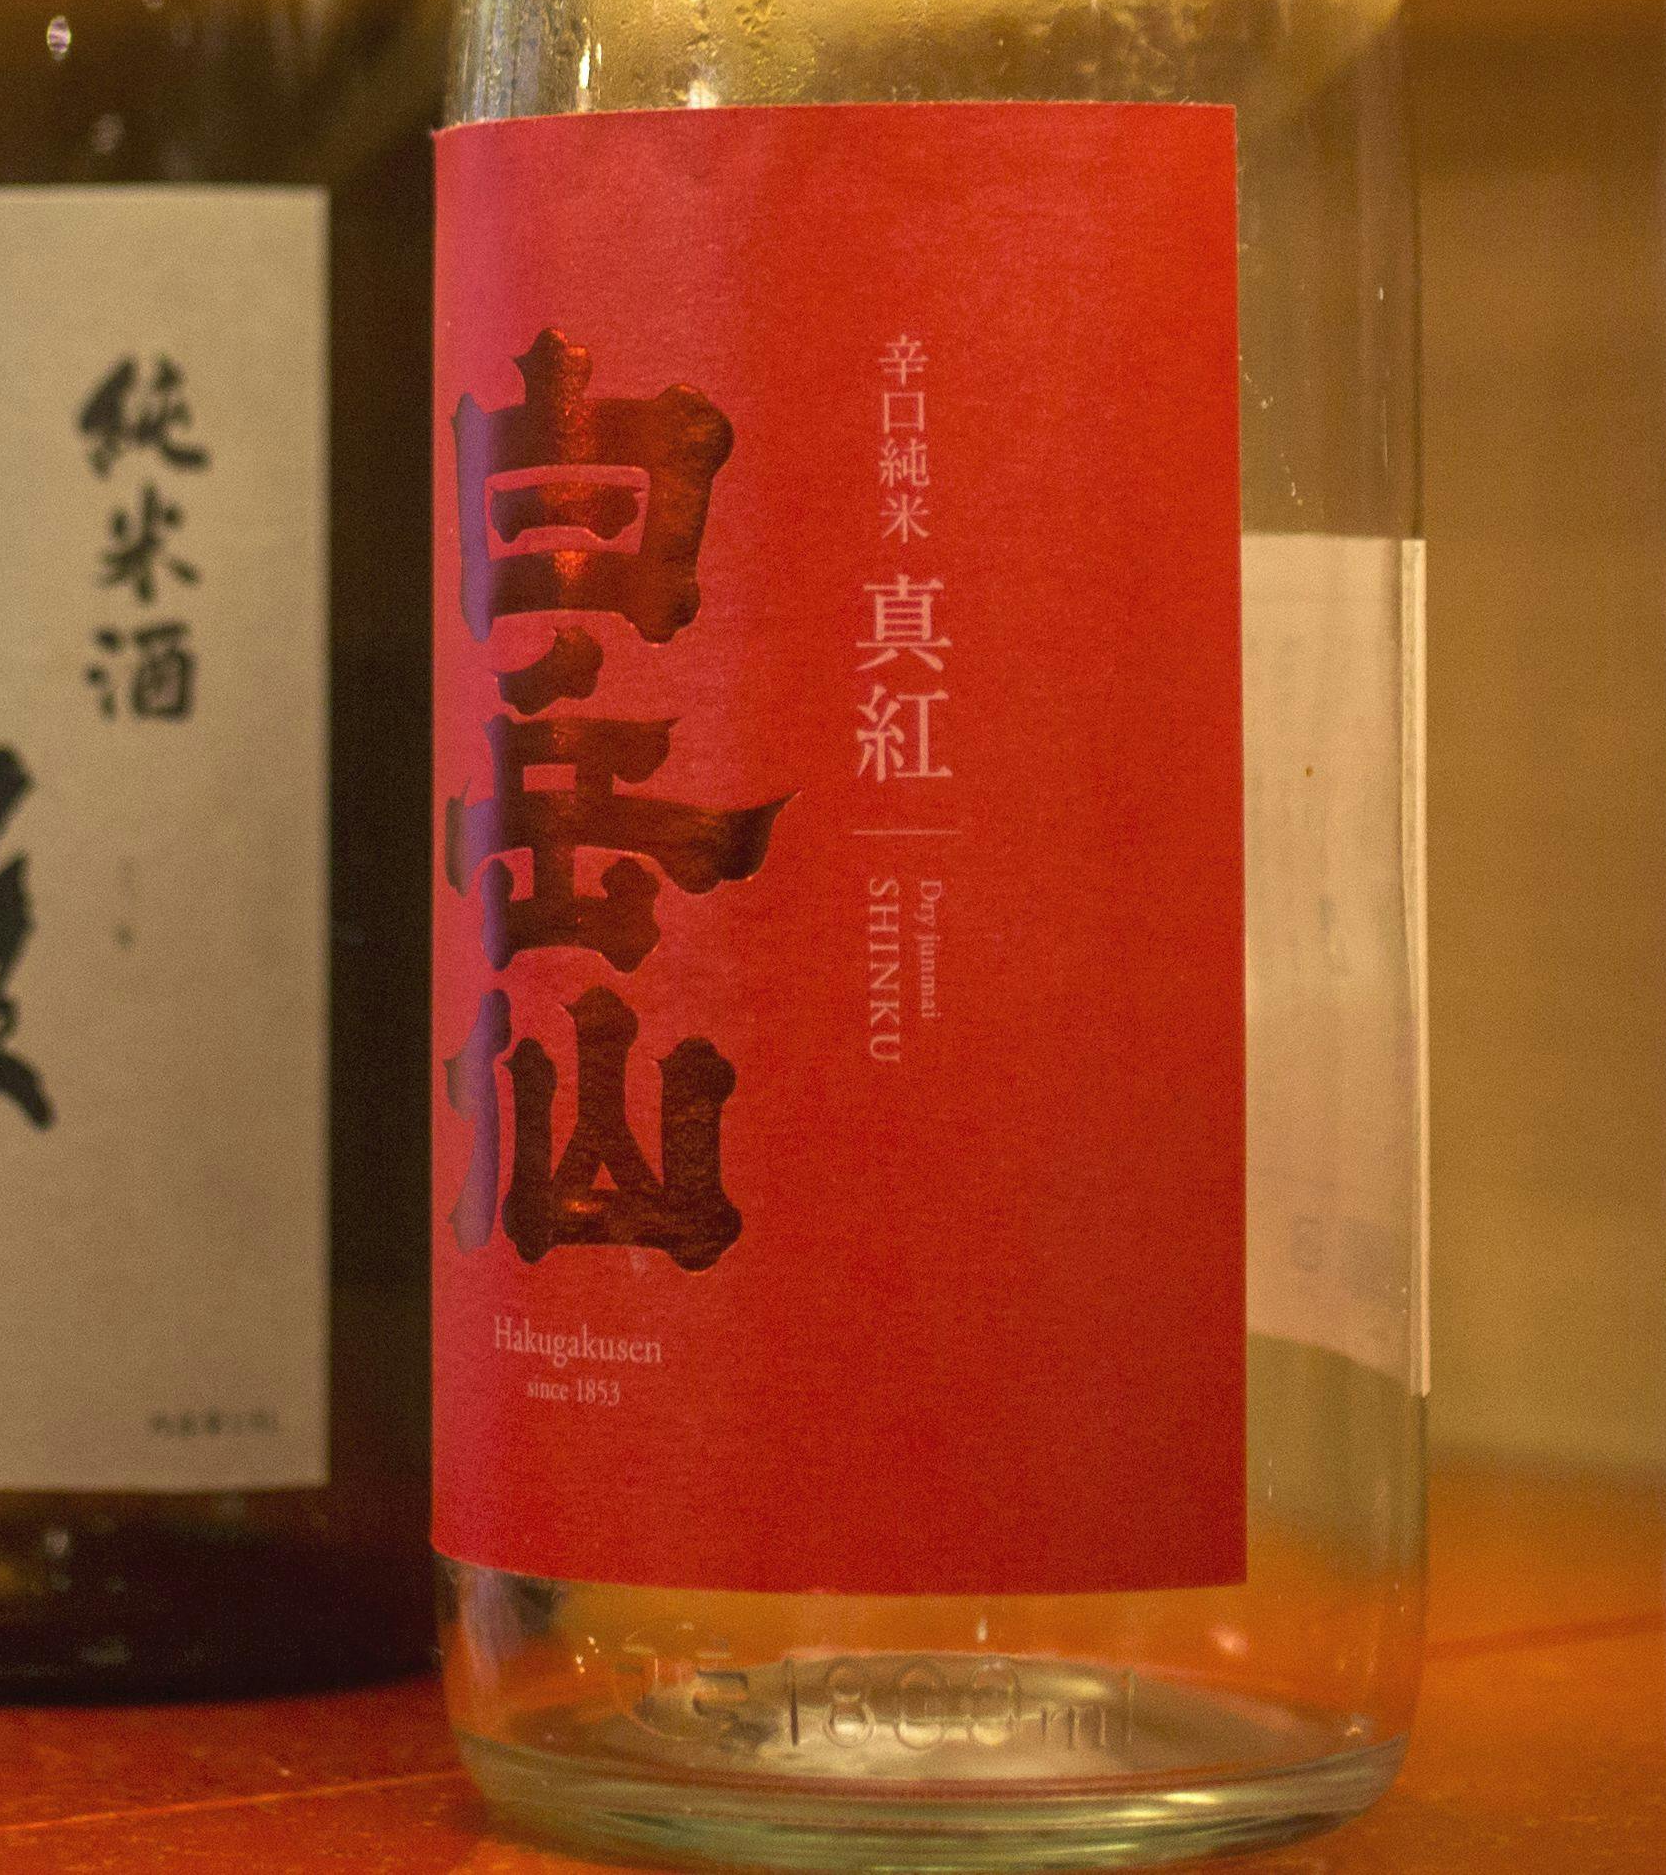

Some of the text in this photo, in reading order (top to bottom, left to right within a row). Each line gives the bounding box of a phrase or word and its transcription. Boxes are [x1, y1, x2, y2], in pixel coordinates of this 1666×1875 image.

[77, 353, 211, 723] 純米酒
[854, 333, 953, 784] 辛口純米 真紅
[445, 327, 803, 1272] 白岳仙
[869, 877, 901, 1063] SHINKU
[914, 879, 942, 926] Dry
[493, 1315, 663, 1368] Hakugakusen
[527, 1376, 621, 1407] since 1853
